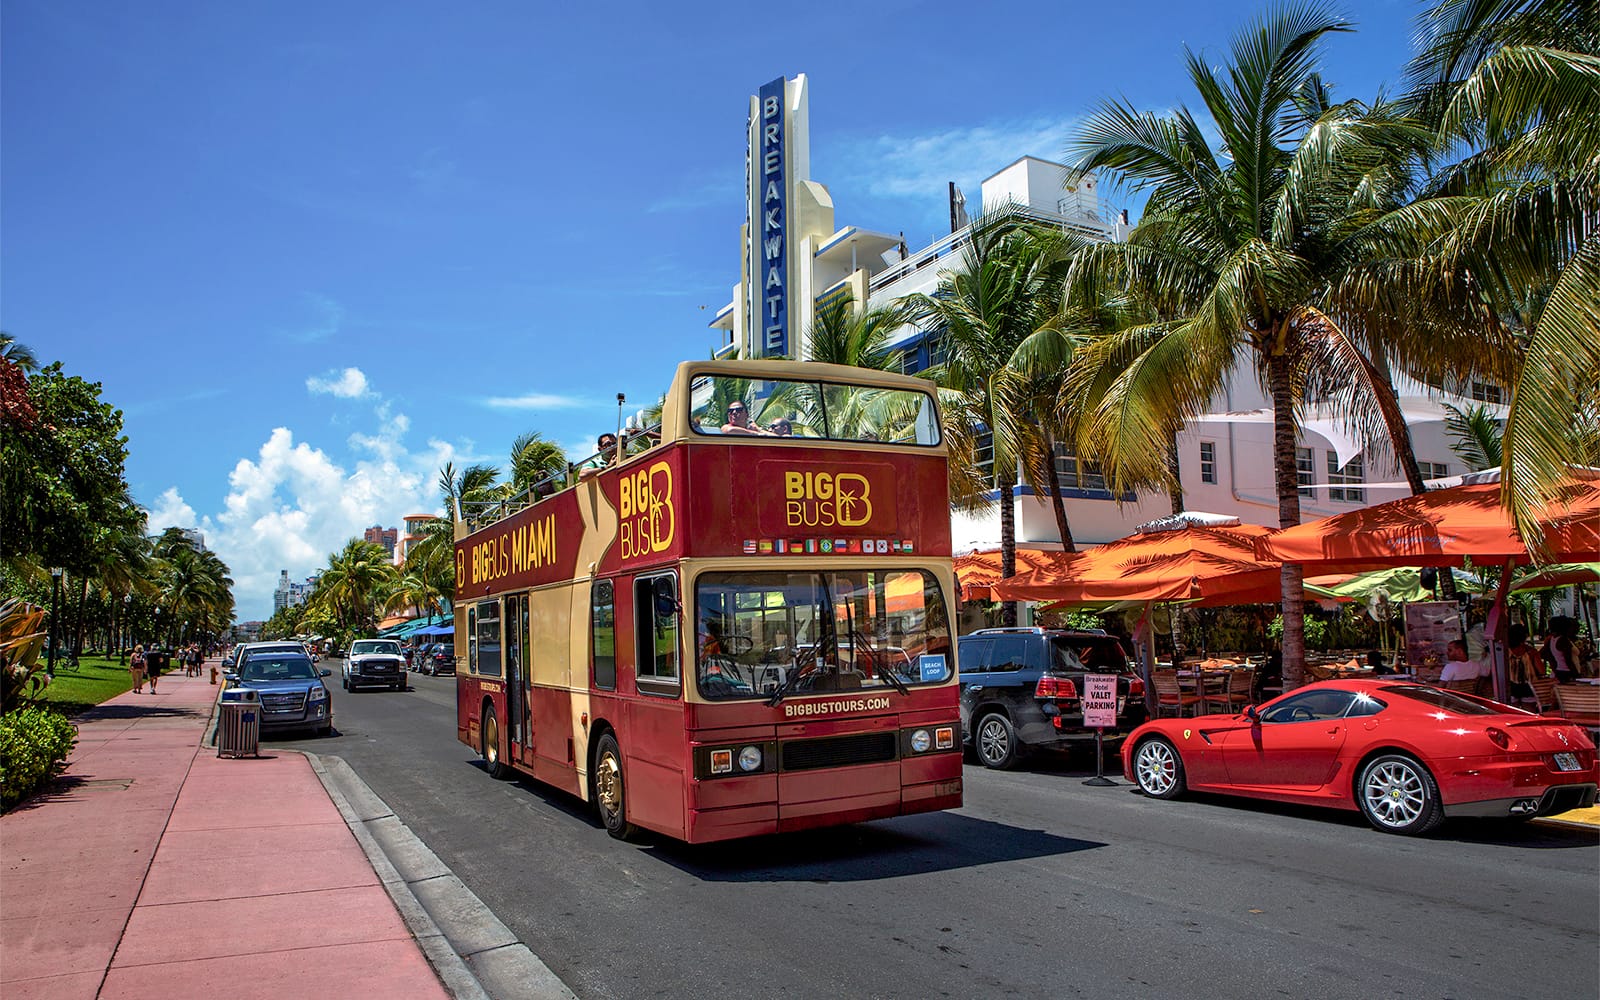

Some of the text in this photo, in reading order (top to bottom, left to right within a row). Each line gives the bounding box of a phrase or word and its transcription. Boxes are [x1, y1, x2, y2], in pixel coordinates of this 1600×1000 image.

[763, 96, 783, 356] BREAKWATE
[620, 469, 649, 519] BIG
[785, 471, 834, 500] BIG
[786, 501, 835, 527] BUS
[512, 513, 556, 575] MIAMI
[621, 516, 650, 560] BUS
[785, 698, 890, 717] BIGBUSTOURS.COM
[1085, 701, 1115, 710] PARKING
[1091, 691, 1111, 700] VALET
